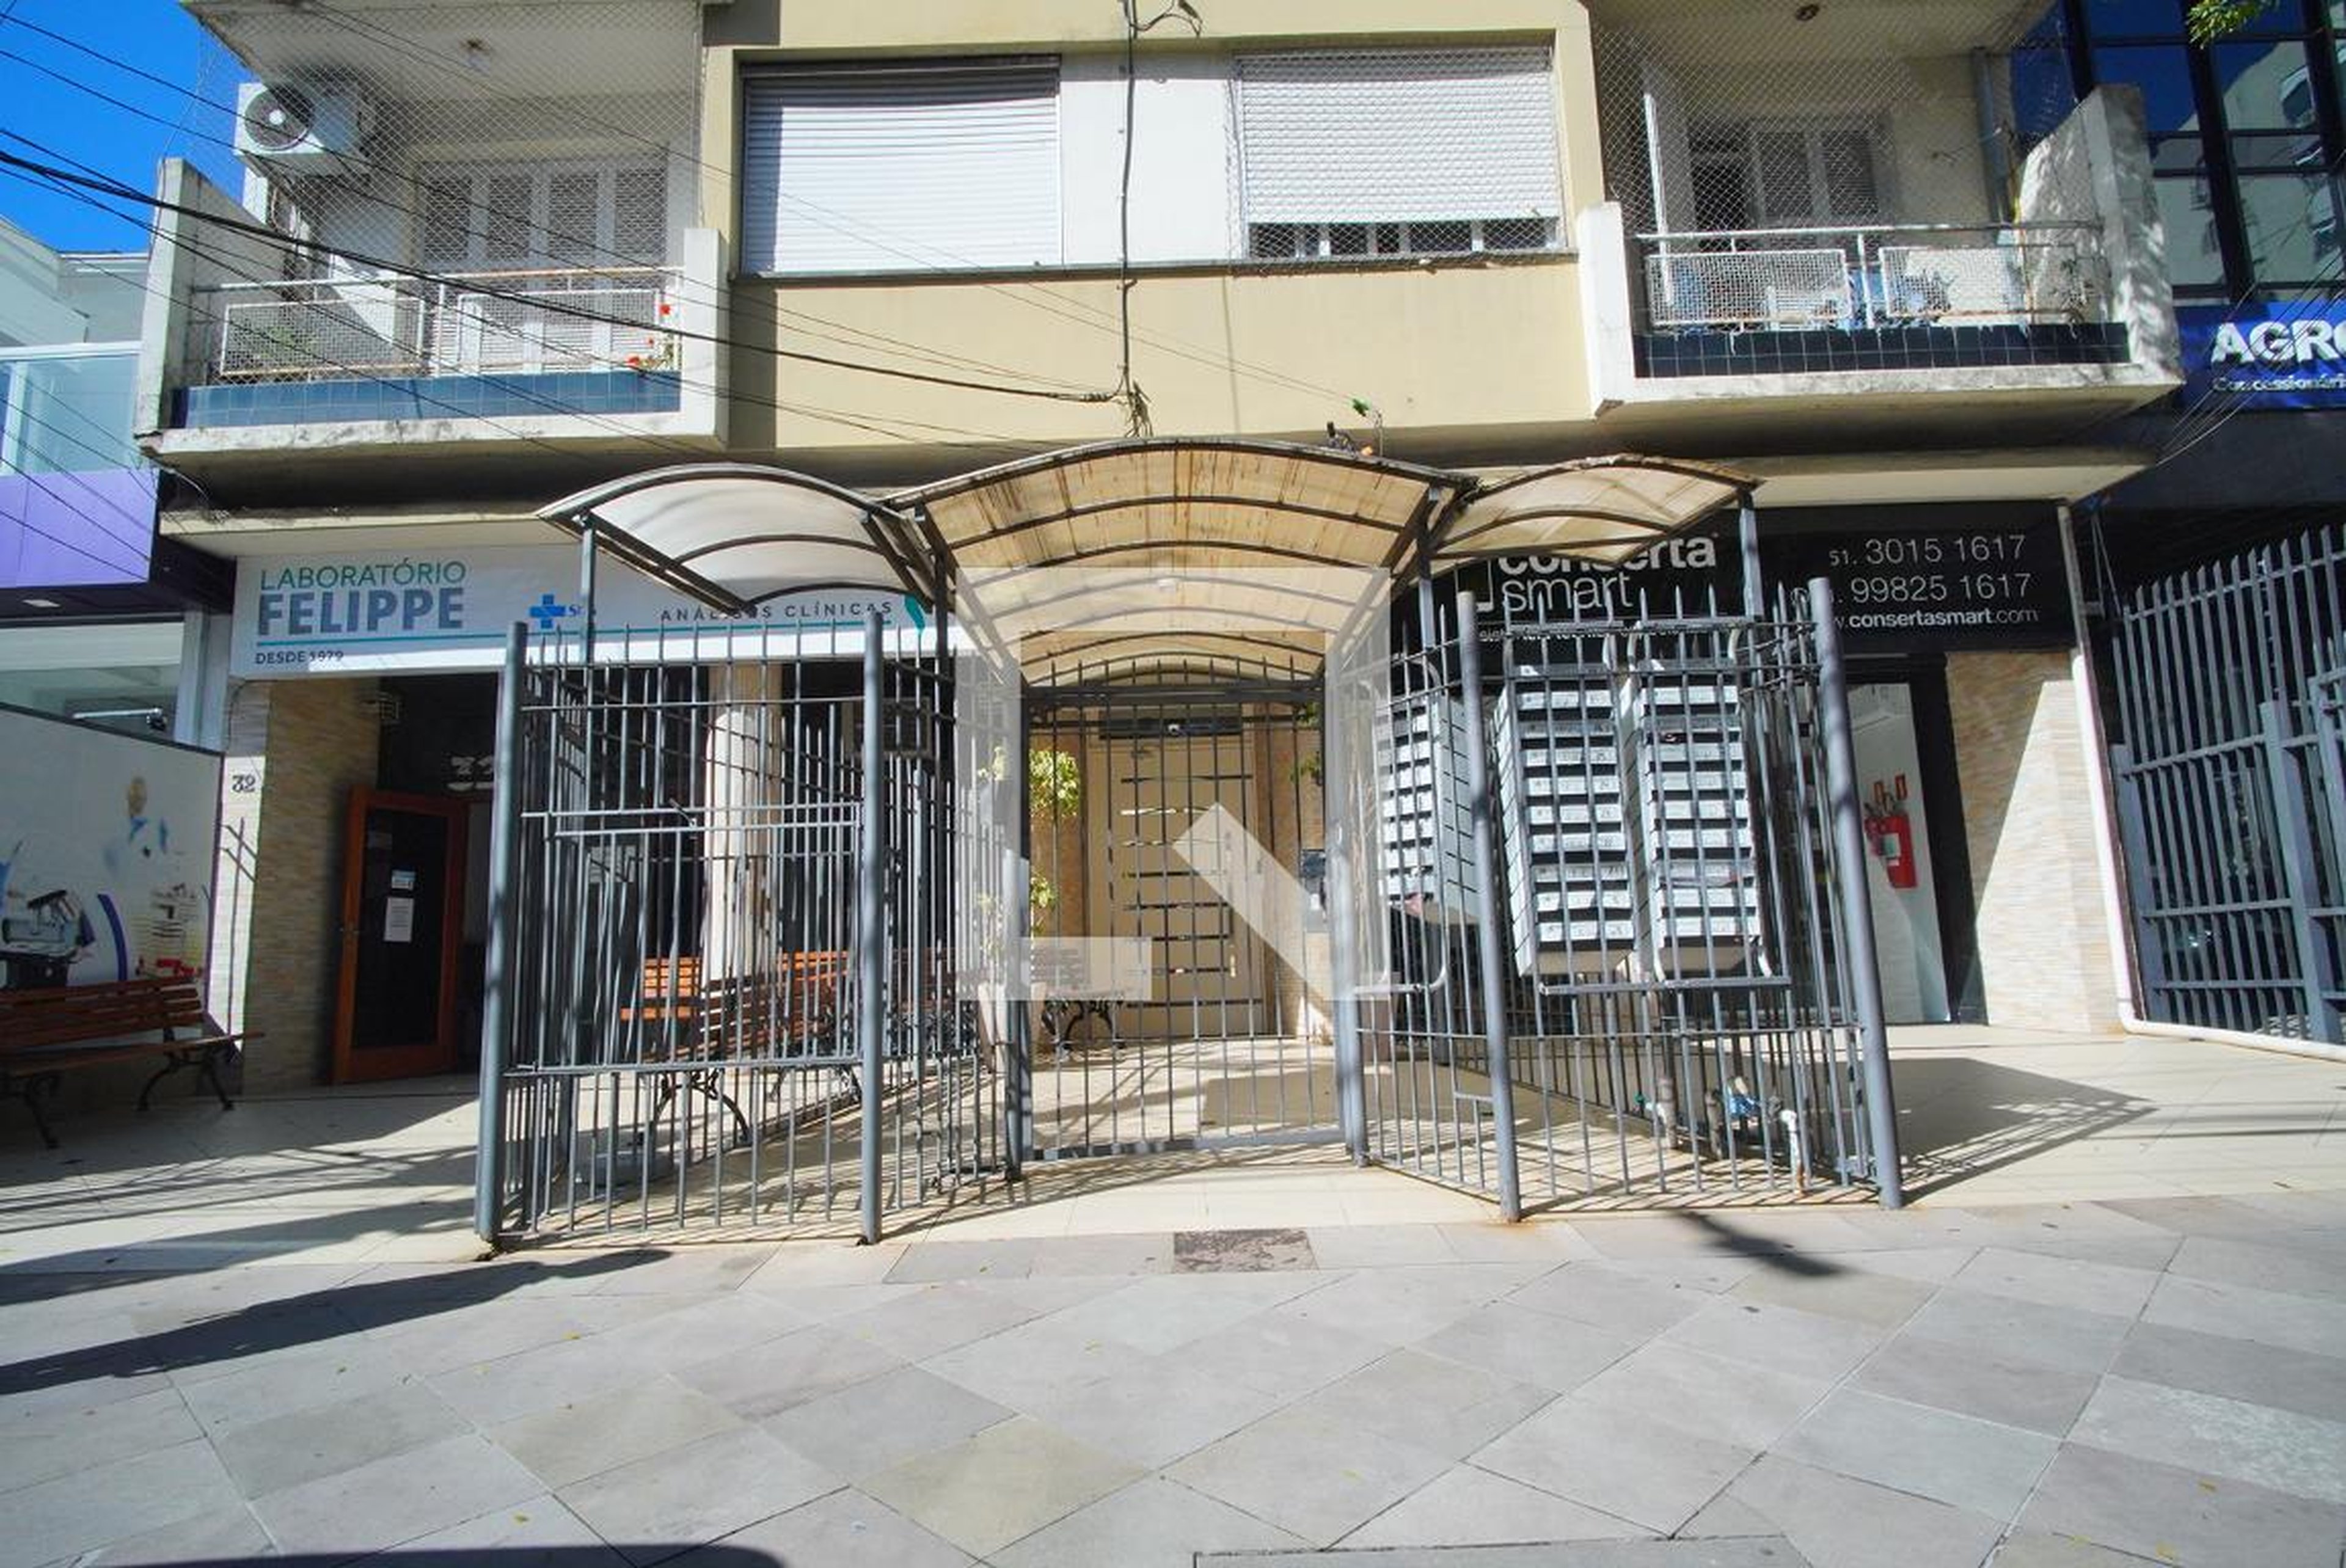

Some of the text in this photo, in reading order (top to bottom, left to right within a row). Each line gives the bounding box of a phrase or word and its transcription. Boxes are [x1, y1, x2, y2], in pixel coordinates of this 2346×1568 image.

[1498, 536, 1716, 575] conerta
[1866, 538, 1942, 564] 3015
[1955, 535, 2025, 561] 1617
[261, 558, 466, 591] LABORATÓRIO
[1851, 574, 1947, 603] 99825
[1959, 572, 2031, 600] 1617
[1501, 571, 1633, 611] smart
[258, 588, 463, 635] FELIPPE
[785, 601, 891, 618] CLÍNICAS
[255, 651, 344, 664] DESDE 1979
